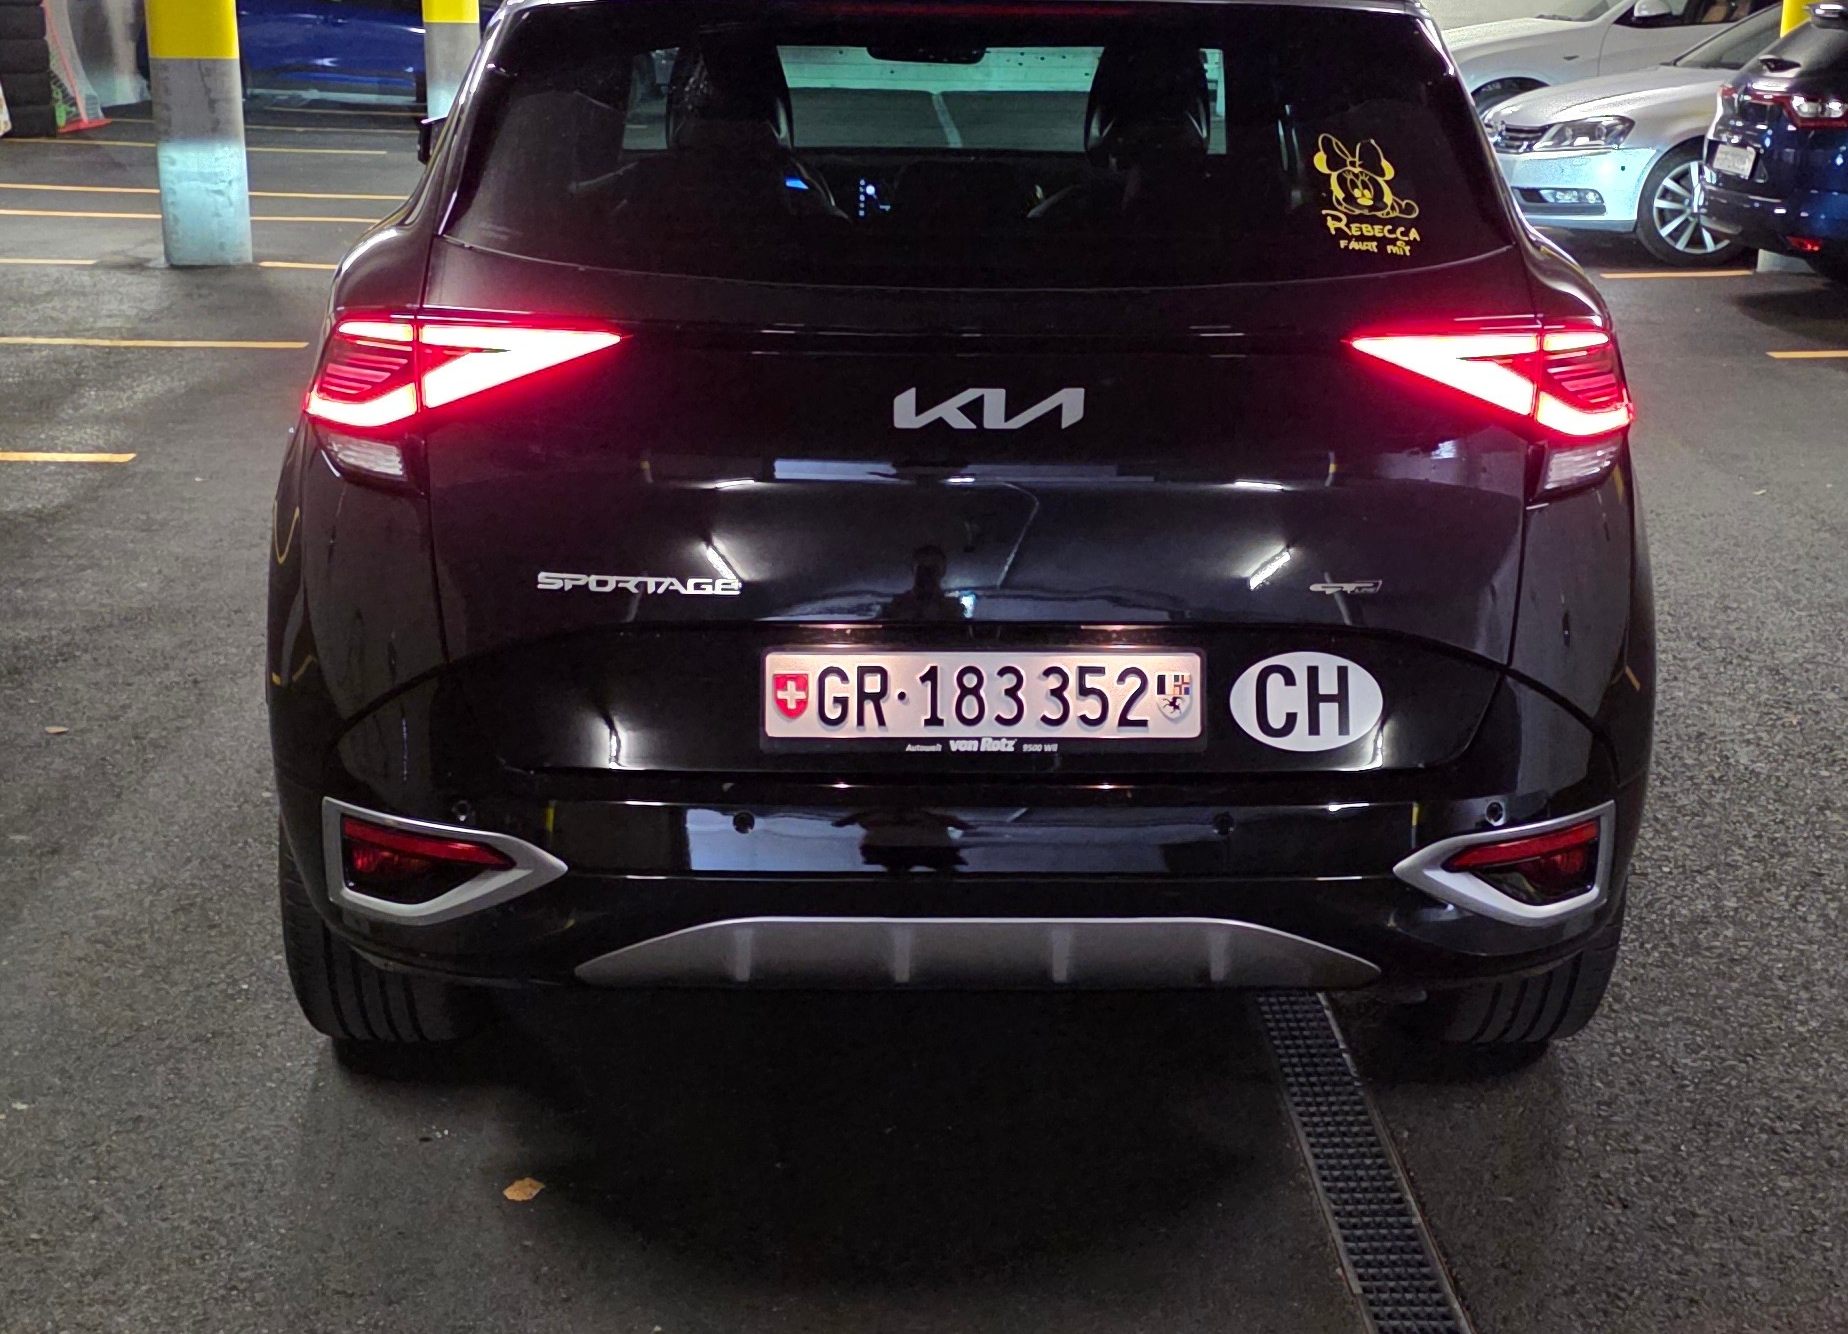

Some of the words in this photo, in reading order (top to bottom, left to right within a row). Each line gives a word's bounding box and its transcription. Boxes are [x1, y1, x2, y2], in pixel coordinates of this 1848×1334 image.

[1321, 209, 1420, 241] REBECCA
[893, 386, 1085, 429] KIA
[536, 571, 742, 596] SPORTAGE
[1255, 663, 1350, 739] CH
[949, 739, 979, 752] von
[980, 737, 1015, 752] Rotz
